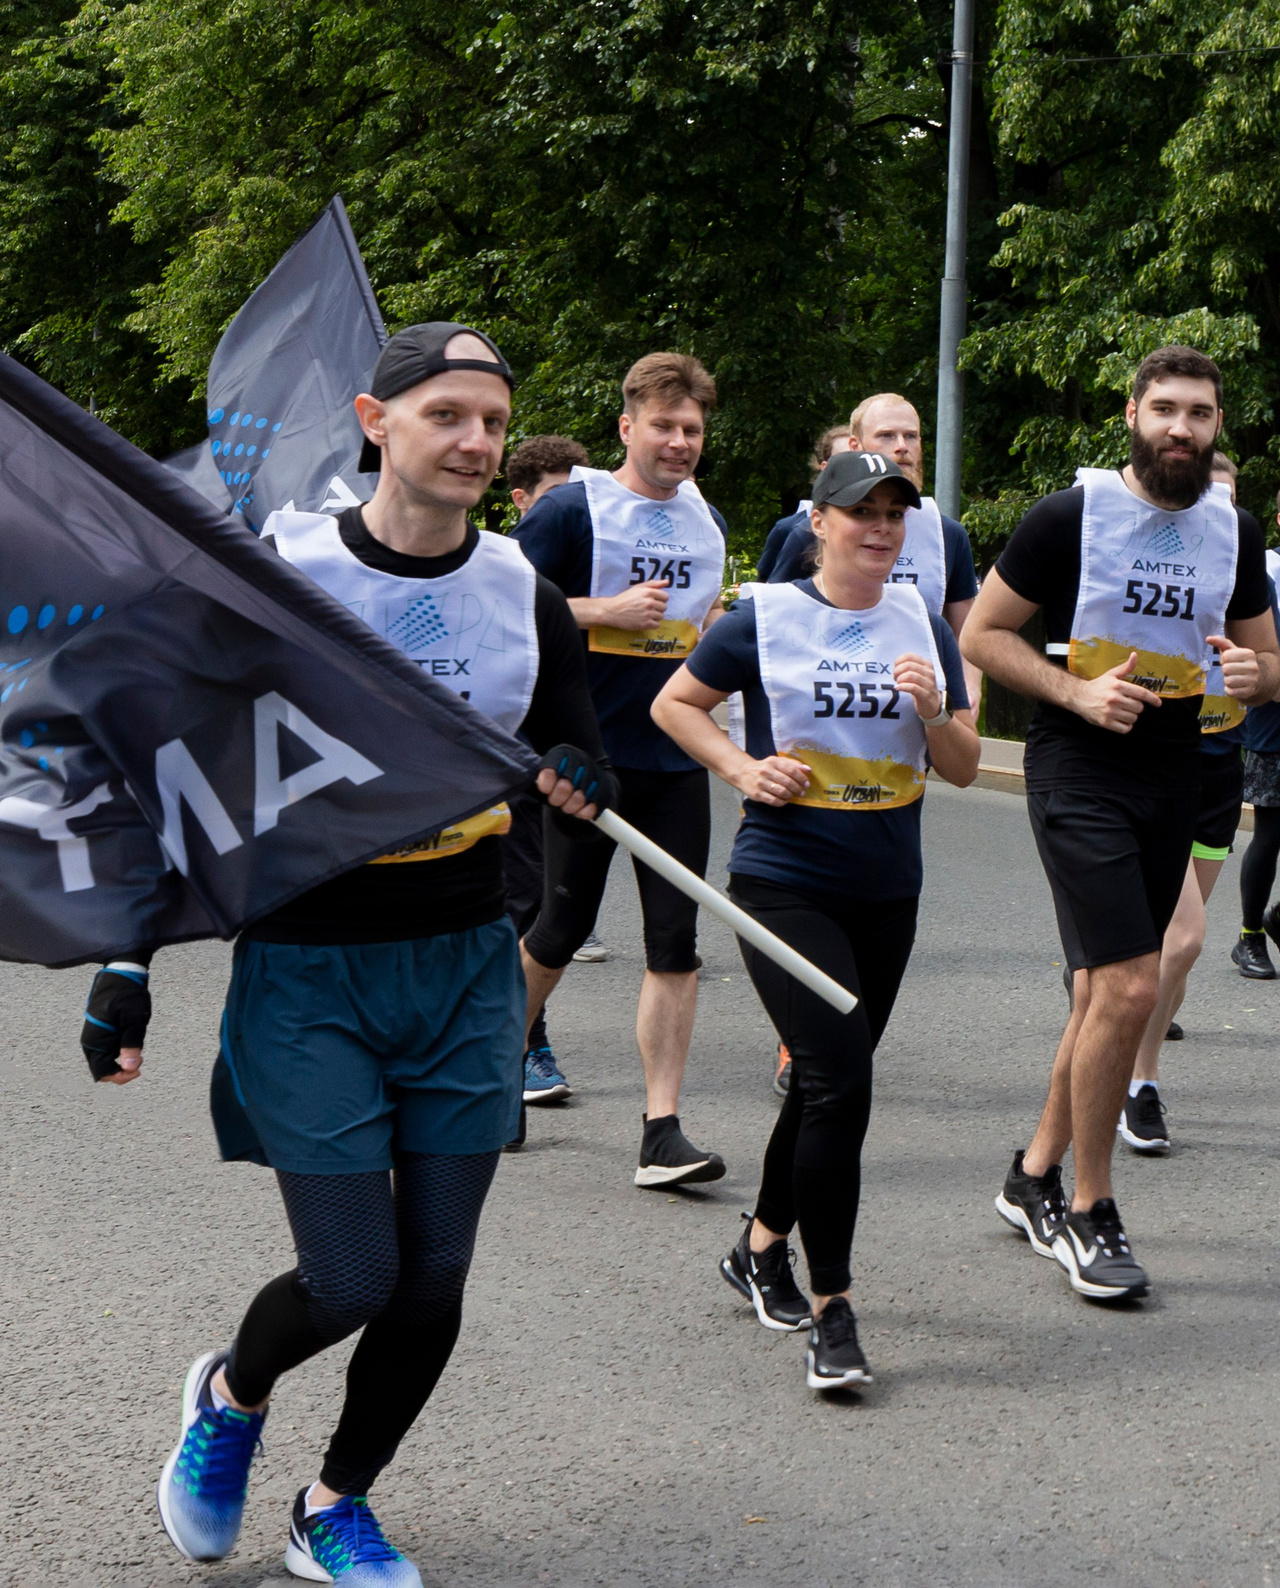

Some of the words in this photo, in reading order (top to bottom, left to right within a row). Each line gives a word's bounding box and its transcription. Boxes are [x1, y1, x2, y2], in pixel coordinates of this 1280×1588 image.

[635, 538, 691, 553] AMTEX
[628, 556, 692, 589] 5265
[1131, 559, 1197, 578] AMTEX
[1122, 579, 1195, 621] 5251
[816, 659, 891, 675] AMTEX
[813, 681, 901, 720] 5252
[842, 782, 881, 804] URBAN
